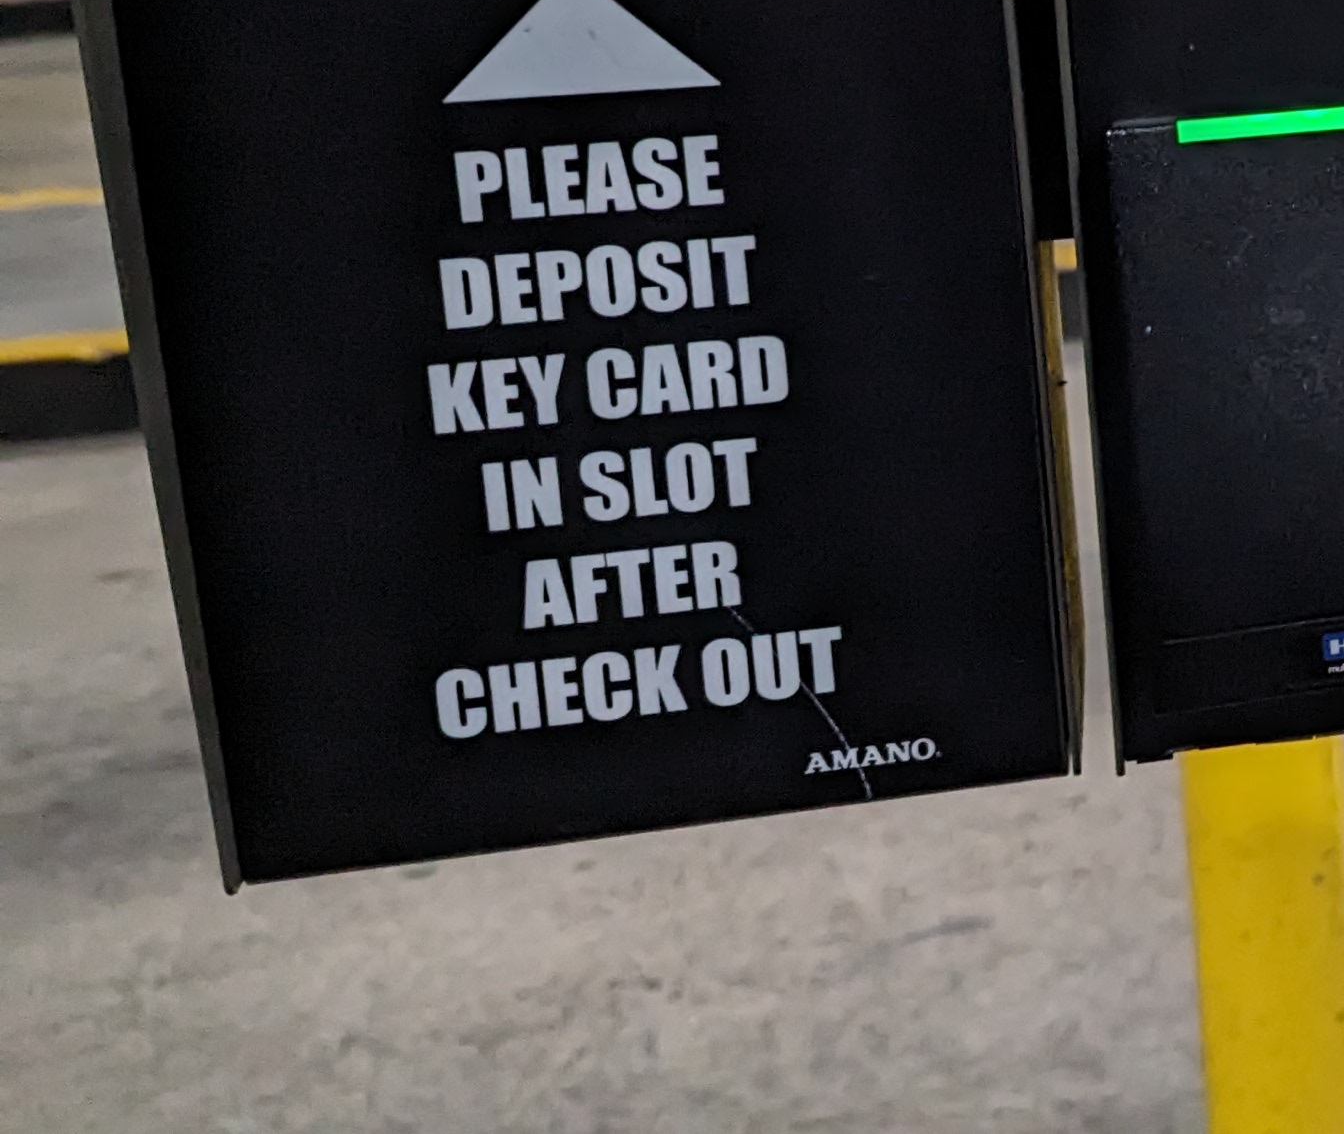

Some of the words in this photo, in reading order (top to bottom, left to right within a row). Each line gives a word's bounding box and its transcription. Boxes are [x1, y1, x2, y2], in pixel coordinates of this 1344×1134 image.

[453, 134, 725, 224] PLEASE
[438, 234, 757, 330] DEPOSIT
[427, 353, 566, 435] KEY
[585, 335, 790, 420] CARD
[482, 456, 564, 533] IN
[579, 437, 758, 522] SLOT
[522, 540, 742, 631] AFTER
[434, 643, 689, 740] CHECK
[701, 626, 842, 708] OUT
